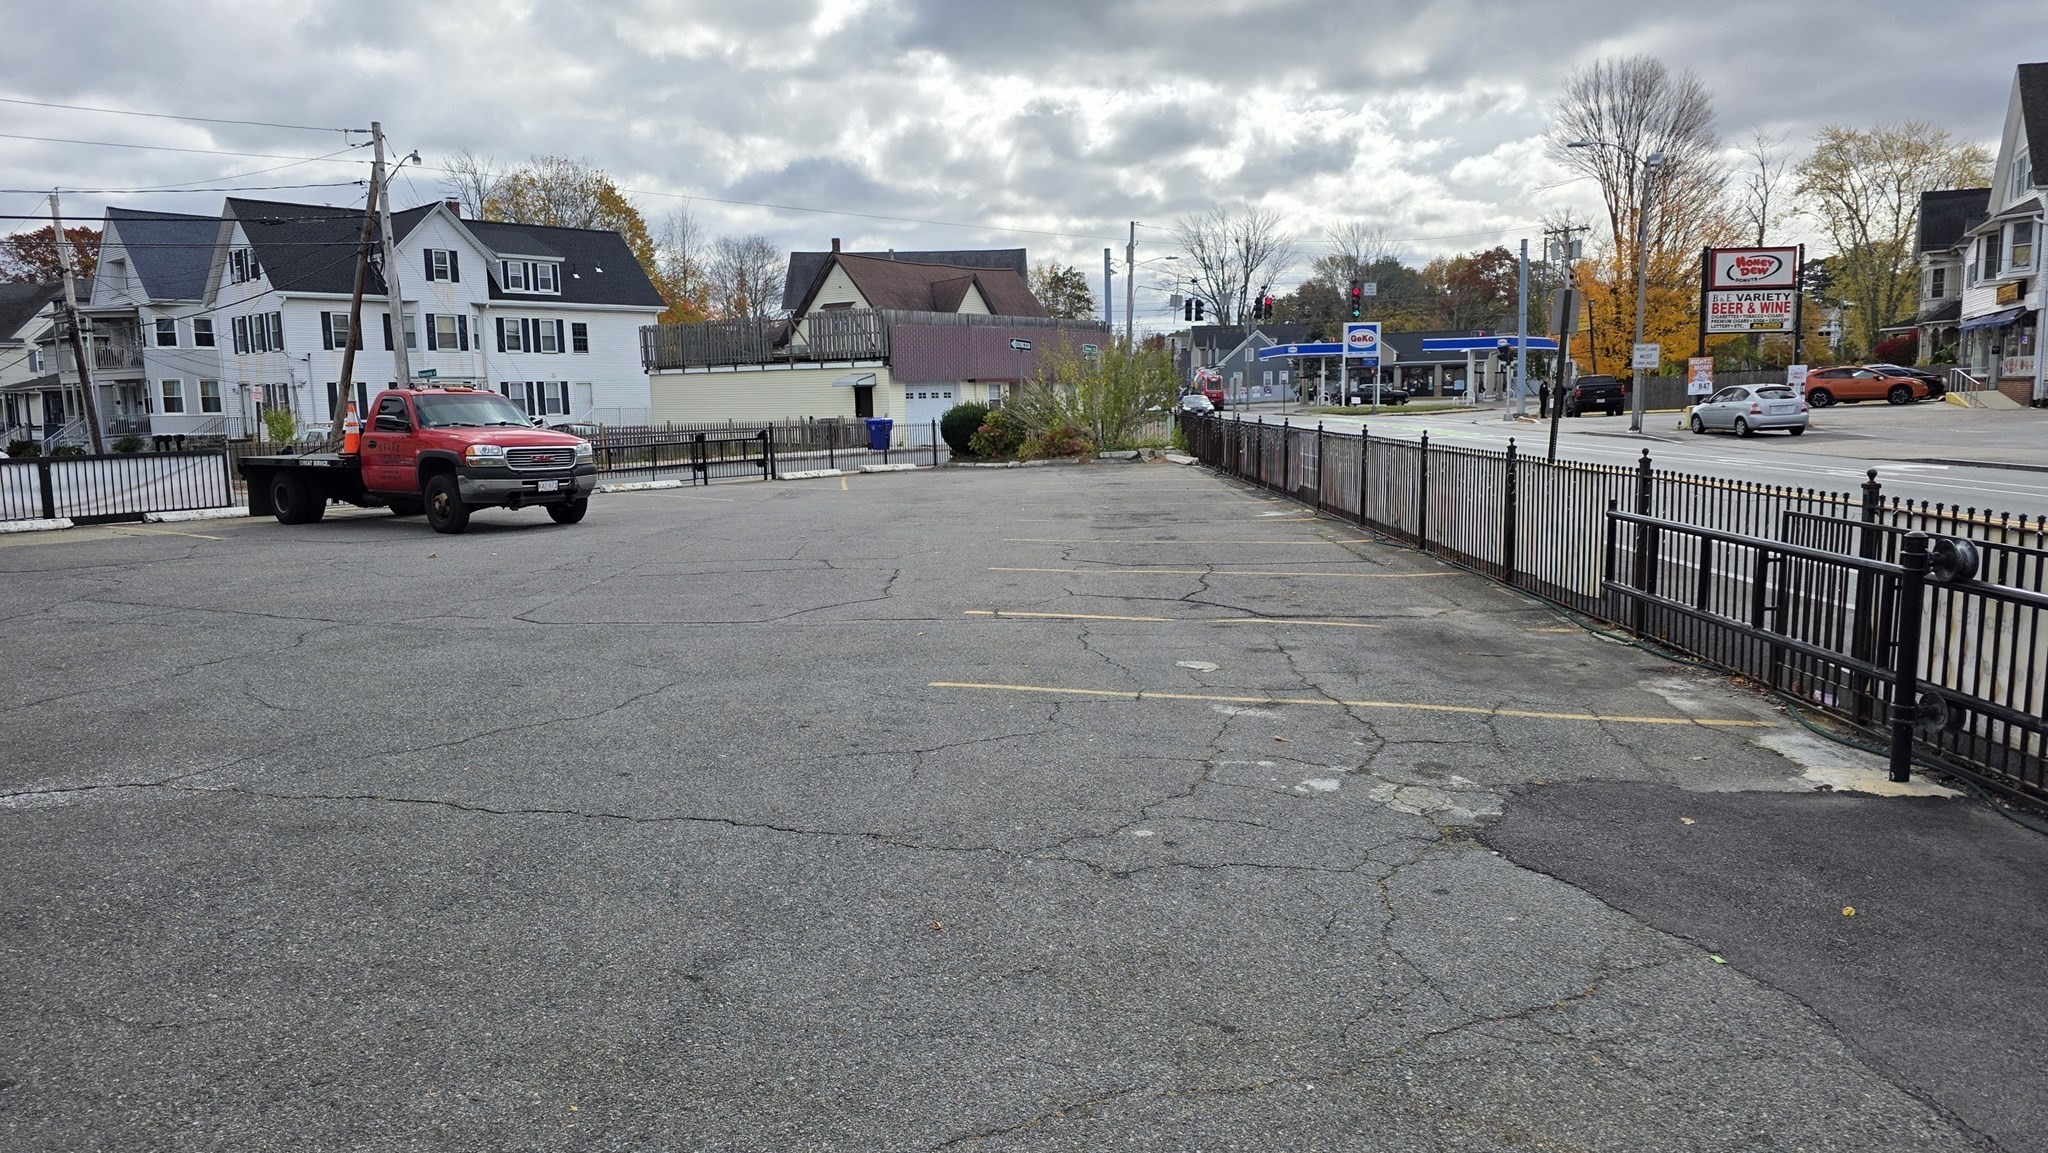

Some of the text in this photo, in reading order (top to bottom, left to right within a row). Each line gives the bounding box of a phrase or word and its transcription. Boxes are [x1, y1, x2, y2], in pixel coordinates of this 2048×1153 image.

[1736, 256, 1774, 268] HONEY
[1740, 267, 1768, 276] DEW
[1736, 293, 1791, 301] VARIETY
[1712, 301, 1791, 314] BEER & WINE
